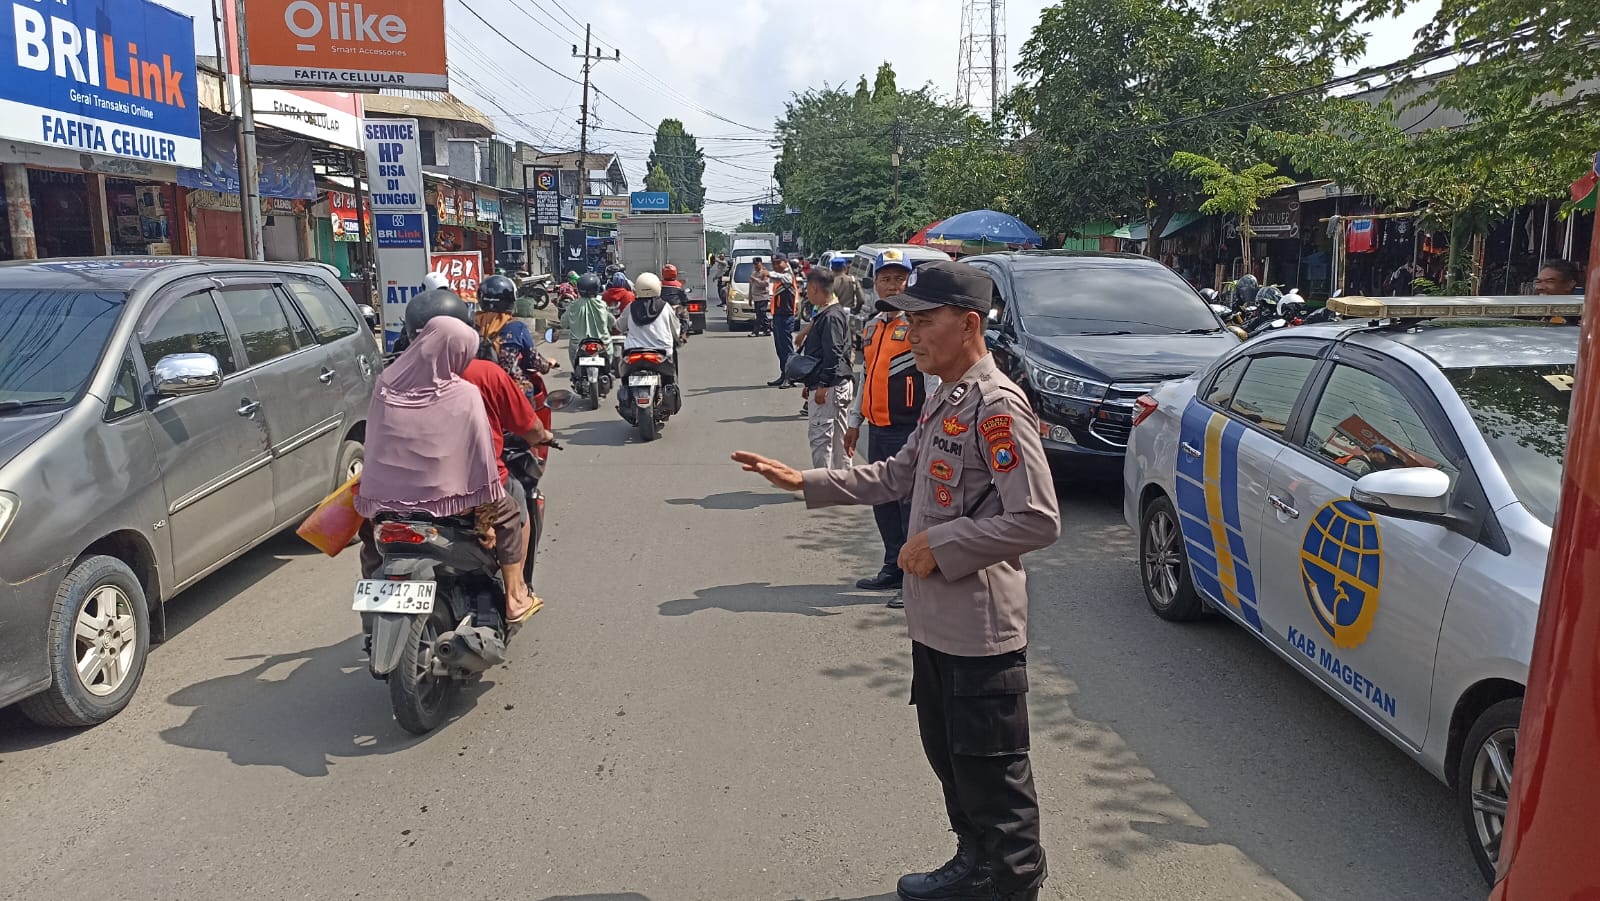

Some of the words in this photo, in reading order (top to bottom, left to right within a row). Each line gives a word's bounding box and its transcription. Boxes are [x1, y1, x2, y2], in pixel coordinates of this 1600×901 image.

[12, 3, 186, 108] BRILink
[331, 45, 356, 55] Smart
[359, 47, 407, 57] Accessories
[294, 69, 336, 80] FAFITA
[341, 72, 405, 84] CELLULAR
[69, 89, 92, 106] Gerai
[94, 94, 130, 115] Transaksi
[131, 103, 154, 120] Online
[42, 115, 107, 151] FAFITA
[111, 129, 177, 163] CELULER
[365, 124, 414, 140] SERVICE
[378, 142, 404, 163] HP
[378, 164, 406, 177] BISA
[387, 178, 400, 191] DI
[371, 193, 417, 205] TUNGGU
[636, 197, 665, 206] vivo
[1266, 212, 1290, 225] SILVER
[378, 229, 421, 239] BRILink
[932, 436, 963, 457] POLRI
[357, 582, 373, 595] AE
[379, 583, 411, 597] 4117
[417, 584, 433, 597] RN
[1287, 625, 1316, 659] KAB
[1319, 647, 1396, 718] MAGETAN
